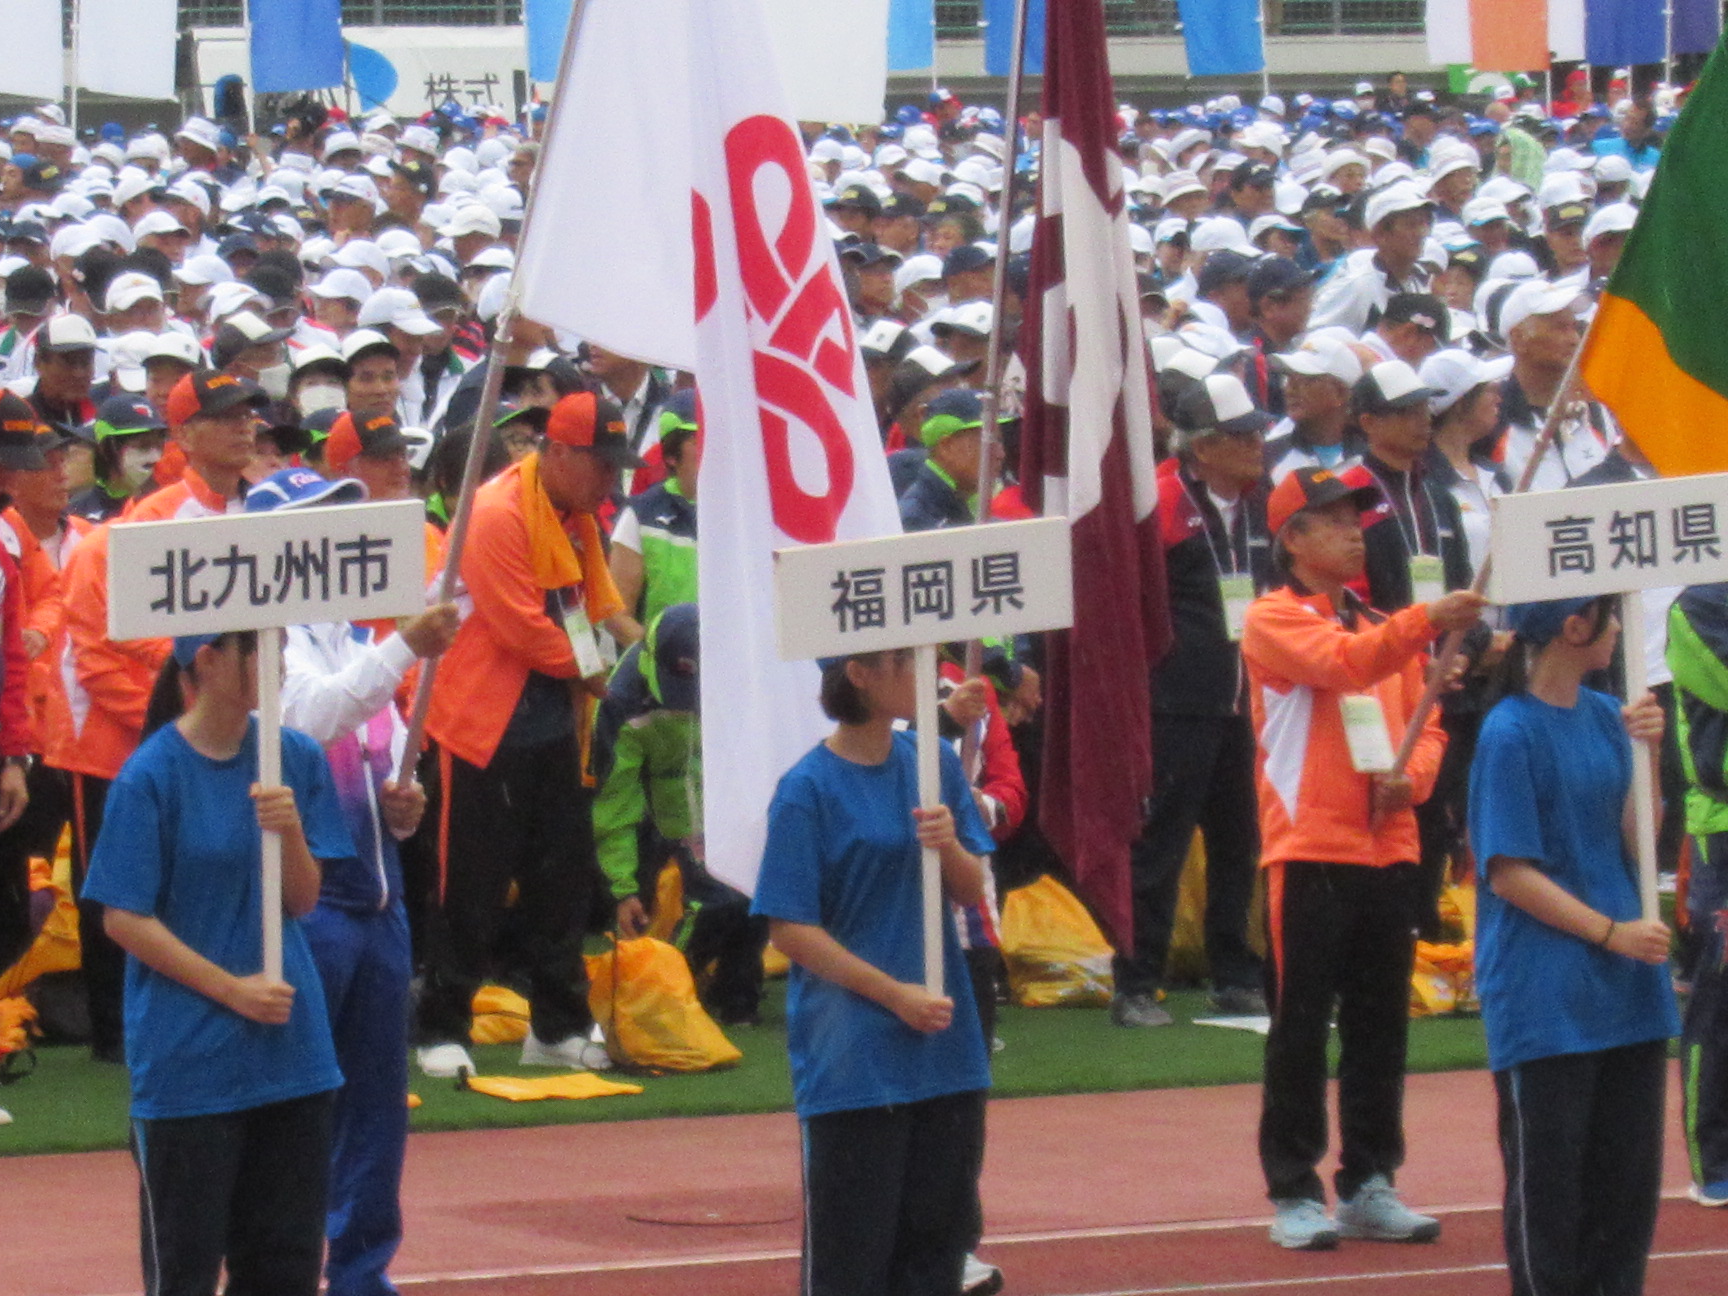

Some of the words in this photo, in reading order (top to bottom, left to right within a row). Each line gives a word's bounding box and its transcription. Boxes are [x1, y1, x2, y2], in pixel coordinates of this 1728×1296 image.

[149, 534, 392, 615] 北九州市
[1545, 504, 1722, 576] 高知県
[830, 552, 1025, 632] 福岡県
